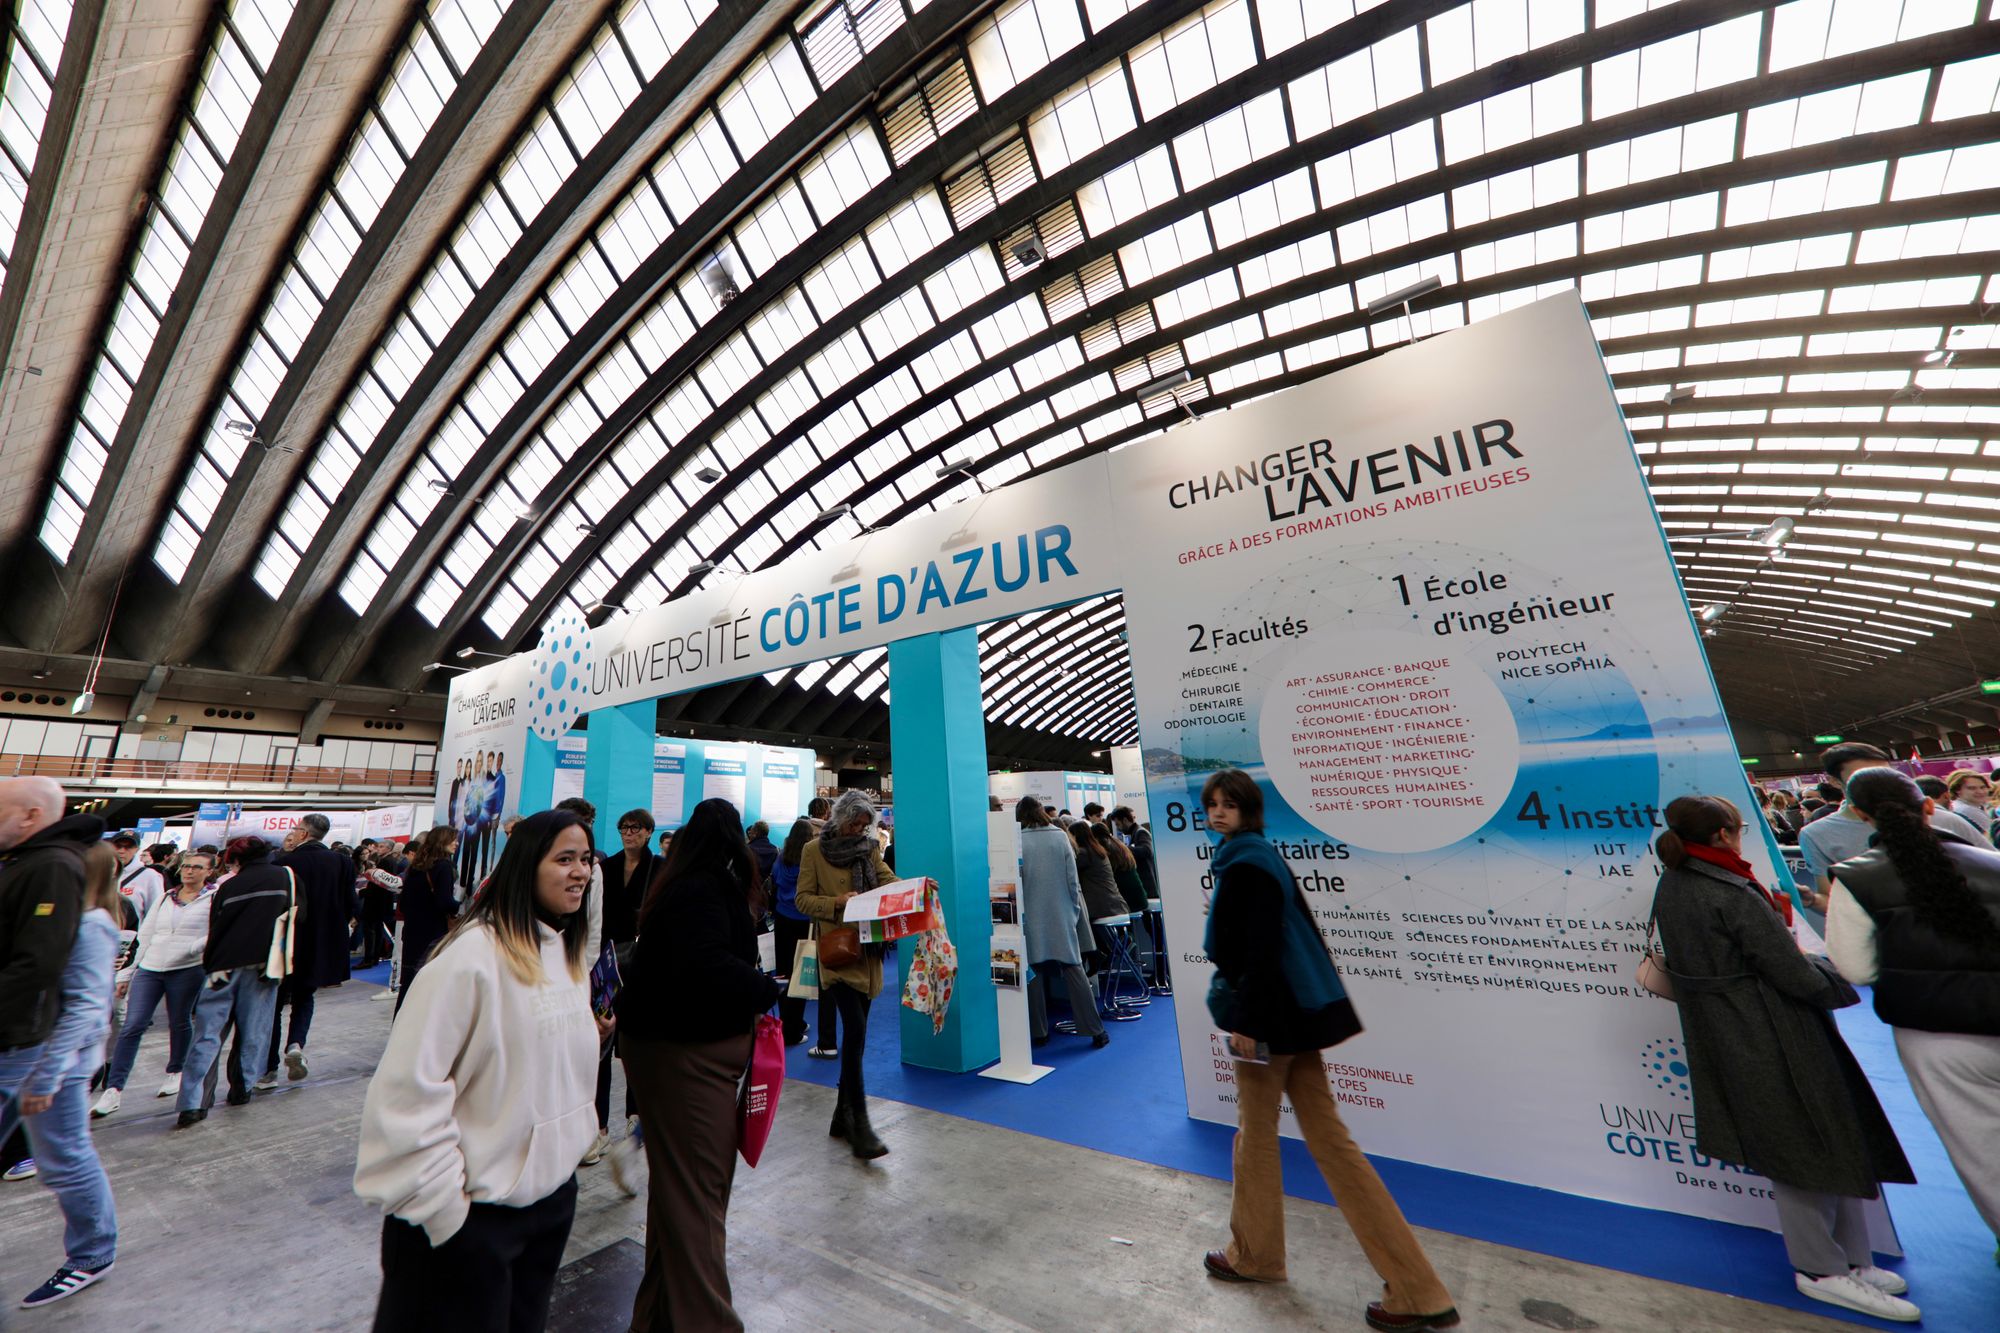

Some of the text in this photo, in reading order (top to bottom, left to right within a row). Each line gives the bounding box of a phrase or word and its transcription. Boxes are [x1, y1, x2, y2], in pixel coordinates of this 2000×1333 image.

[1168, 438, 1336, 509] CHANGER
[1263, 417, 1525, 522] L'AVENIR
[1177, 466, 1531, 565] GRÂCE À DES FORMATIONS AMBITIEUSES
[1392, 570, 1508, 606] 1 École
[591, 524, 1080, 697] UNIVERSITÉ CÔTE D'AZUR
[1433, 589, 1616, 637] d'ingénieur
[1187, 616, 1309, 652] 2 Facultés
[1496, 641, 1587, 663] POLYTECH
[1182, 662, 1239, 679] MÉDECINE
[1286, 658, 1450, 688] ART ASSURANCE BANQUE
[1501, 655, 1617, 681] NICE SOPHIA
[1181, 682, 1242, 699] CHIRURGIE
[1308, 676, 1430, 699] CHIMIE COMMERCE
[458, 692, 490, 713] CHANGER
[473, 698, 516, 725] L'AVENIR
[1190, 697, 1244, 712] DENTAIRE
[1296, 688, 1451, 714] COMMUNICATION DROIT
[1164, 712, 1247, 729] ODONTOLOGIE
[1302, 704, 1450, 727] ÉCONOMIE ÉDUCATION
[1291, 718, 1463, 742] ENVIRONNEMENT FINANCE
[1293, 733, 1468, 756] INFORMATIQUE INGÉNIERIE
[1298, 748, 1471, 769] MANAGEMENT MARKETING
[1310, 765, 1462, 783] NUMÉRIQUE PHYSIQUE
[1312, 780, 1467, 797] RESSOURCES HUMAINES
[1315, 796, 1484, 812] SANTÉ SPORT TOURISME
[1517, 791, 1665, 830] 4 Instit
[263, 817, 302, 831] ISEN
[1166, 802, 1188, 832] 8
[1196, 839, 1350, 861] unitaires
[1594, 843, 1627, 857] IUT
[1600, 864, 1634, 877] IAE
[1323, 910, 1390, 922] HUMANITÉS
[1402, 912, 1464, 925] SCIENCES
[1467, 915, 1487, 927] DU
[1490, 916, 1541, 928] VIVANT
[1546, 918, 1565, 929] ET
[1568, 920, 1588, 930] DE
[1592, 921, 1611, 930] LA
[1331, 929, 1394, 942] POLITIQUE
[1406, 932, 1468, 945] SCIENCES
[1472, 935, 1597, 952] FONDAMENTALES
[1601, 941, 1618, 952] ET
[1327, 947, 1617, 974] ANAGEMENT SOCIÉTÉ ET ENVIRONNEMENT
[1347, 966, 1361, 976] LA
[1363, 967, 1403, 980] SANTÉ
[1414, 970, 1480, 986] SYSTÈMES
[1483, 977, 1581, 994] NUMÉRIQUES
[1585, 983, 1630, 997] POUR
[1322, 1062, 1415, 1086] FESSIONNELLE
[1338, 1078, 1368, 1092] CPES
[1337, 1092, 1386, 1110] MASTER
[1600, 1103, 1696, 1139] UNIVE
[1606, 1131, 1685, 1164] CÔTE
[1675, 1171, 1776, 1200] Dare to cre
